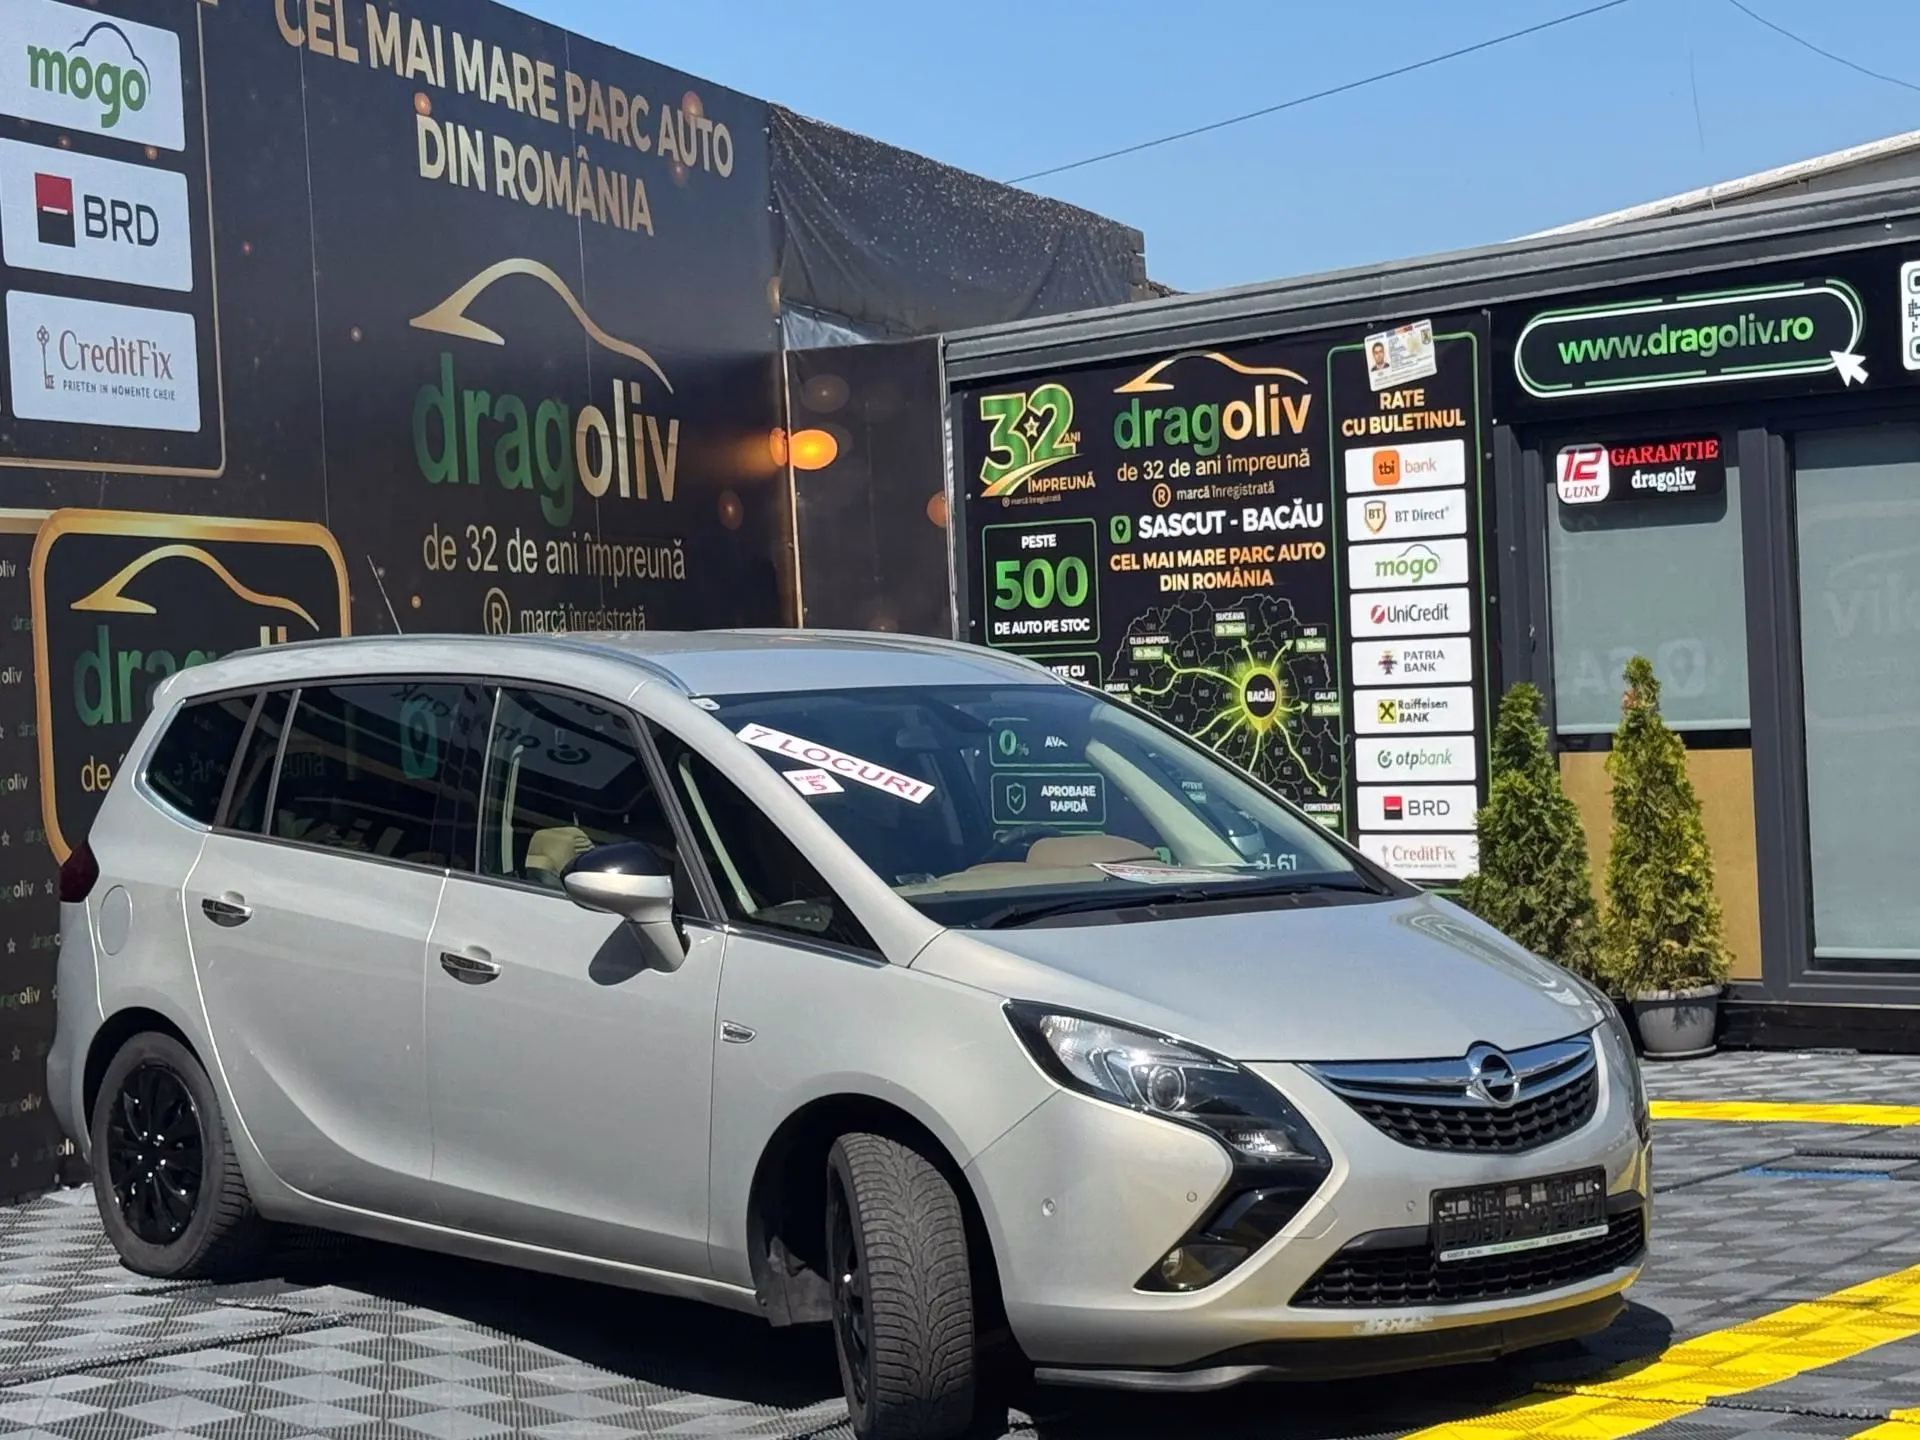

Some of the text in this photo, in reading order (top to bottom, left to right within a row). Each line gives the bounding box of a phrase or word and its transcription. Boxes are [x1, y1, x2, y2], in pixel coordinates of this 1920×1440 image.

[27, 44, 147, 128] mogo
[275, 0, 734, 178] CEL MAI MARE PARC AUTO
[416, 114, 654, 237] DIN ROMÂNIA
[83, 194, 159, 247] BRD
[1557, 313, 1814, 365] www.dragoliv.ro
[59, 330, 173, 380] CreditFix
[1380, 389, 1425, 410] RATE
[1113, 384, 1312, 456] dragoliv
[1341, 408, 1466, 437] CU BULETINUL
[412, 352, 679, 527] dragoliv
[979, 383, 1075, 486] 32
[1064, 432, 1081, 443] ANI
[1117, 448, 1310, 482] de 32 de ani împreună
[1563, 449, 1600, 481] 12
[1611, 440, 1719, 466] GARANTIE
[1377, 458, 1437, 476] tbi bank
[1631, 466, 1696, 491] dragoliv
[1027, 471, 1096, 493] ÎMPREUNĂ
[1564, 485, 1600, 499] LUNI
[1138, 510, 1226, 540] SASCUT
[1242, 499, 1324, 532] BACĂU
[1368, 508, 1381, 520] BT
[1394, 510, 1408, 523] BT
[1021, 534, 1057, 550] PESTE
[423, 523, 686, 588] de 32 de ani împreună
[1110, 542, 1325, 571] CEL MAI MARE PARC AUTO
[1160, 568, 1274, 592] DIN ROMÂNIA
[1375, 557, 1439, 583] mogo
[994, 558, 1089, 610] 500
[1387, 603, 1449, 624] UniCredit
[994, 618, 1090, 635] DE AUTO PE STOC
[1403, 650, 1445, 661] PATRIA
[1403, 662, 1436, 673] BANK
[1070, 665, 1085, 677] CU
[1247, 688, 1276, 703] BACĂU
[1398, 698, 1448, 711] Raiffeisen
[1399, 712, 1430, 723] BANK
[750, 728, 923, 798] 7 LOCURI
[1396, 749, 1453, 770] otpbank
[81, 756, 111, 792] de
[1040, 784, 1097, 799] APROBARE
[1050, 798, 1089, 813] RAPIDĂ
[1408, 800, 1450, 816] BRD
[1392, 845, 1456, 861] CreditFix
